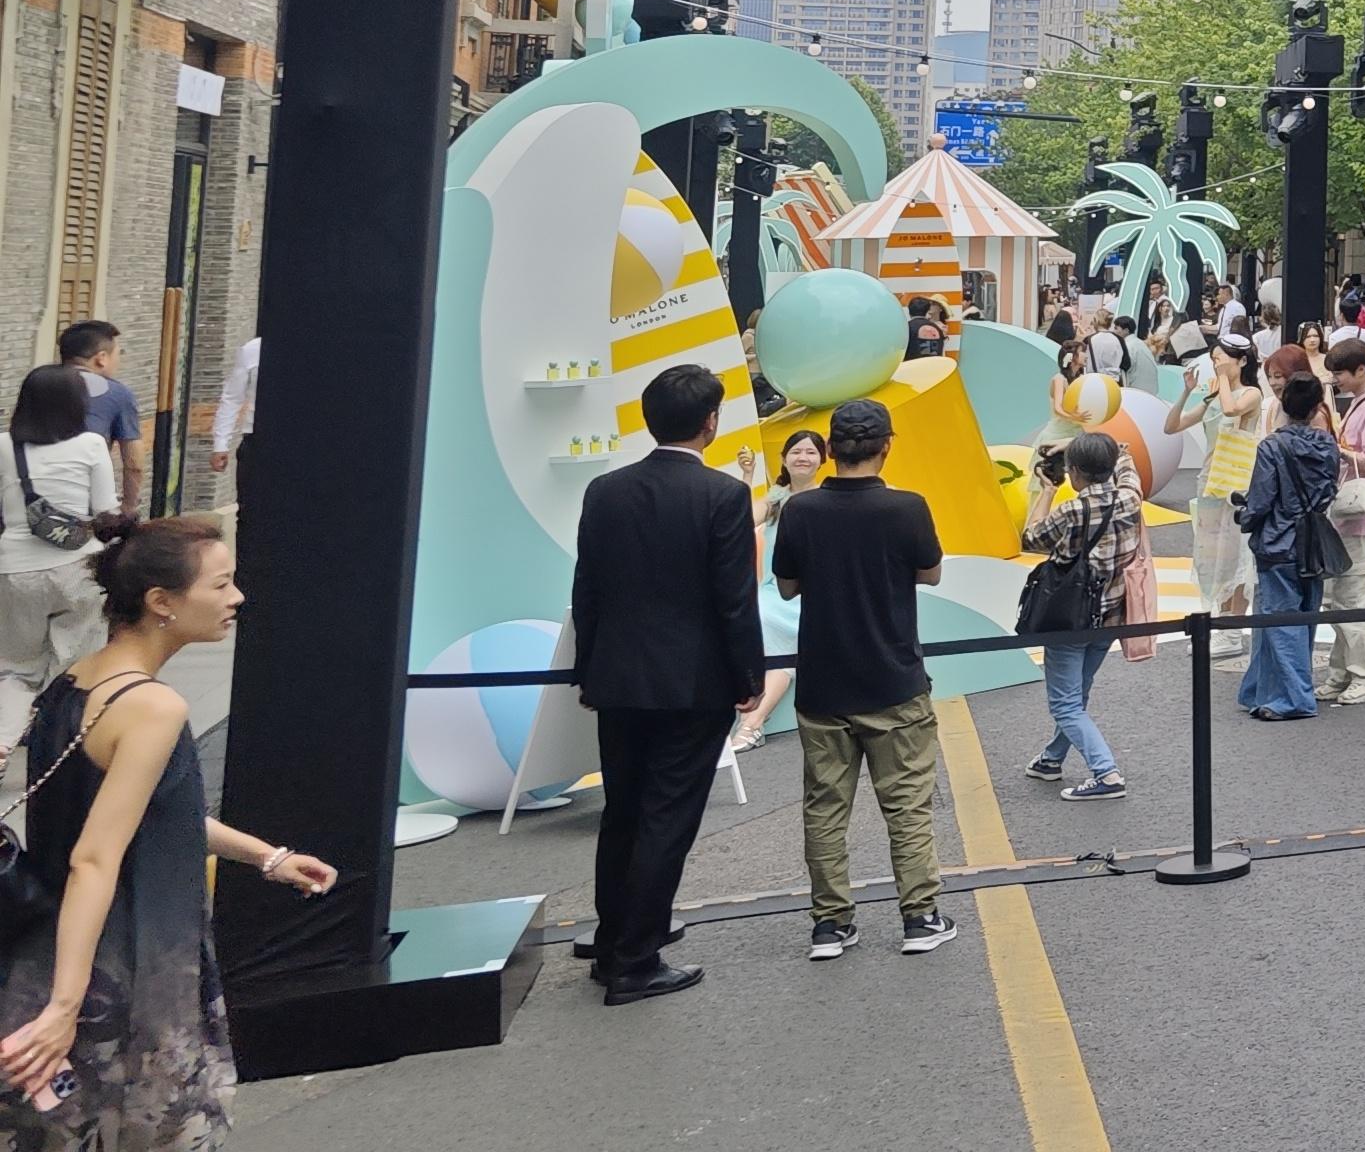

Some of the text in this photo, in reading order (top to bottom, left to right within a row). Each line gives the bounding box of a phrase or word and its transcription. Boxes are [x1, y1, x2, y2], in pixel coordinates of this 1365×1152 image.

[940, 126, 985, 137] 石门一路
[630, 314, 667, 329] LONDON
